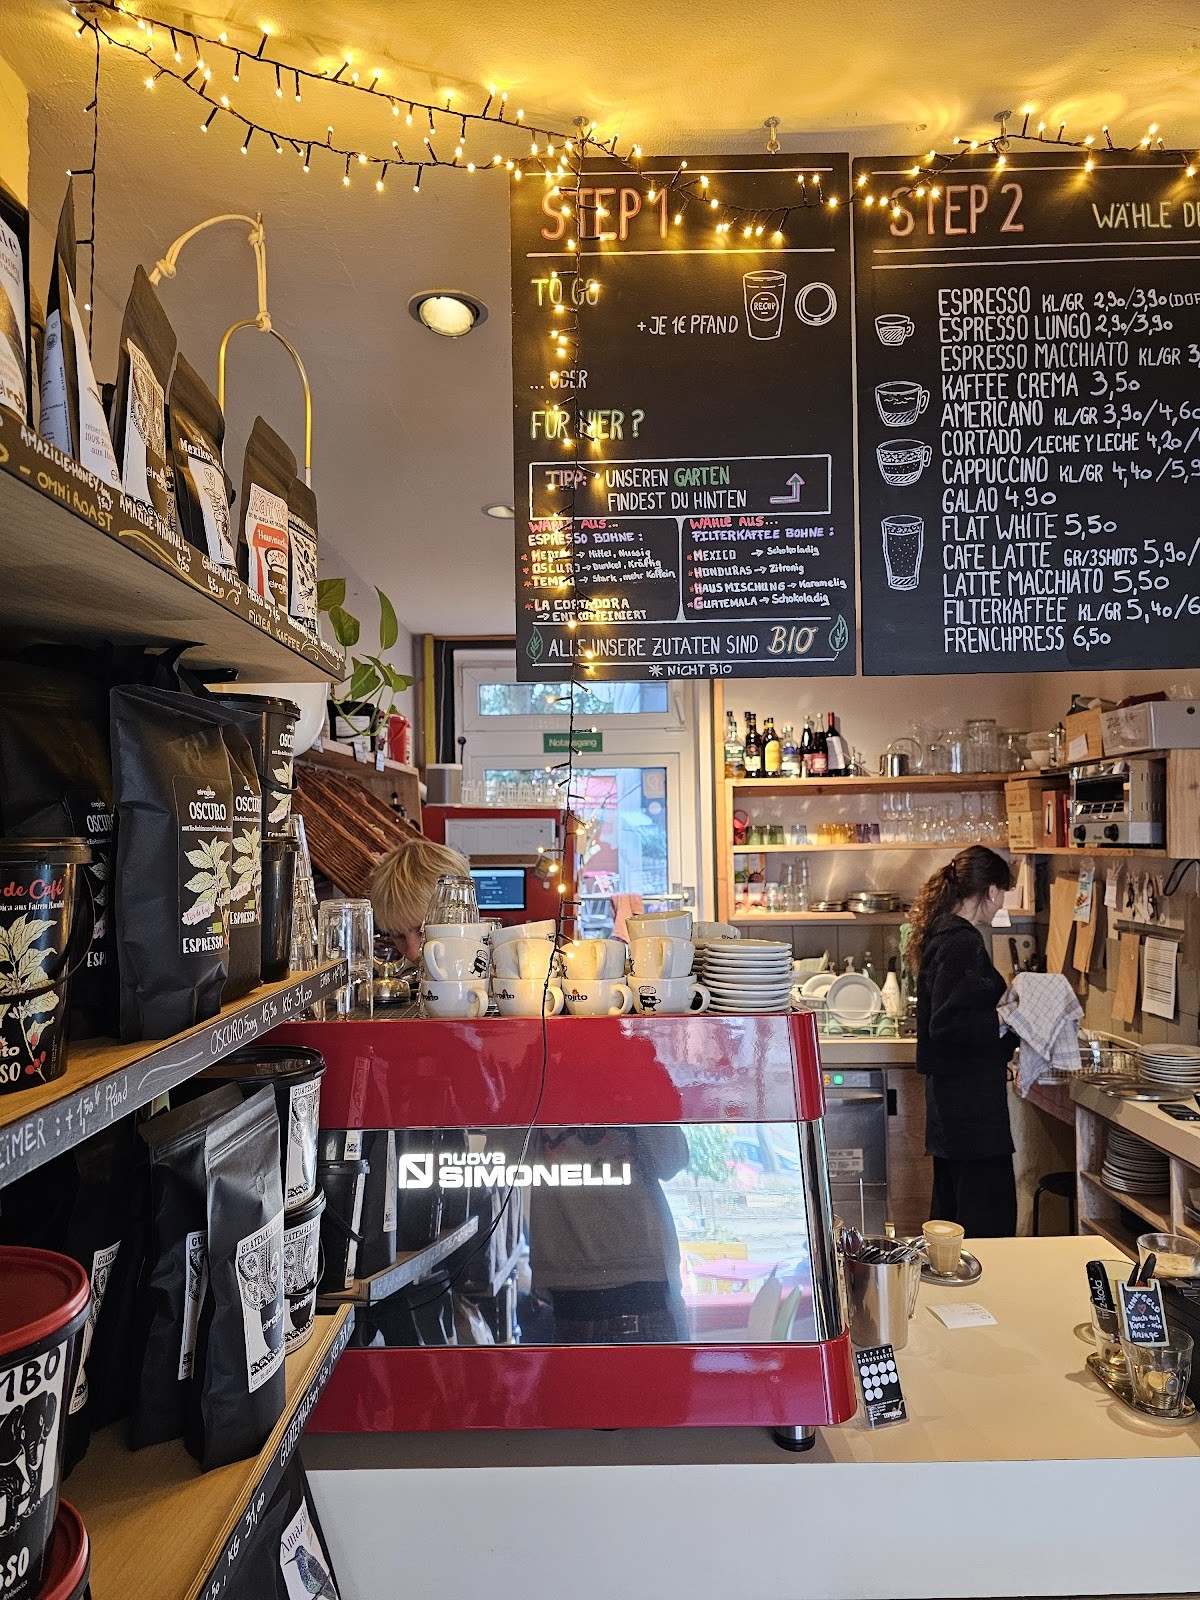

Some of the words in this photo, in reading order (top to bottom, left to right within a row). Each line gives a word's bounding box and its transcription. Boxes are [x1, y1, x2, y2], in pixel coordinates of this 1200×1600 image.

[541, 187, 641, 240] STEP
[651, 187, 668, 239] 1
[890, 184, 988, 237] STEP
[1001, 183, 1024, 232] 2
[1091, 202, 1172, 229] WÄHLE
[531, 278, 562, 306] TO
[572, 278, 599, 305] GO
[938, 286, 1031, 316] ESPRESSO
[1042, 293, 1085, 313] KL/GR
[1094, 286, 1167, 312] 2,90/3,90
[753, 302, 776, 311] RECUP
[690, 314, 739, 335] PFAND
[939, 315, 1029, 343] ESPRESSO
[1034, 313, 1091, 341] LUNGO
[1095, 311, 1173, 336] 2,90/3,90
[940, 345, 1028, 371] ESPRESSO
[1034, 341, 1128, 370] MACCHIATO
[1138, 347, 1181, 366] KL/GR
[941, 372, 1009, 400] KAFFEE
[1017, 369, 1078, 399] CREMA
[1090, 370, 1141, 399] 3,50
[578, 409, 625, 441] HIER
[631, 409, 646, 438] ?
[941, 400, 1043, 428] AMERICANO
[1054, 406, 1098, 426] KL/GR
[941, 428, 1021, 456] CORTADO
[1084, 434, 1095, 452] Y
[1097, 432, 1140, 453] LECHE
[1146, 427, 1200, 454] 4,20/
[605, 468, 668, 488] UNSEREN
[673, 466, 731, 487] GARTEN
[942, 456, 1049, 485] CAPPUCCINO
[1060, 464, 1104, 483] KL/GR
[73, 492, 113, 531] ROAST
[607, 492, 666, 512] FINDEST
[671, 491, 689, 510] DU
[694, 489, 747, 509] HINTEN
[942, 487, 999, 513] GALAO
[1005, 486, 1057, 511] 4,90
[528, 532, 588, 546] ESPRESSO
[594, 532, 635, 544] BOHNE
[692, 529, 780, 542] FILTERKAFFEE
[786, 527, 824, 538] BOHNE
[942, 516, 989, 541] FLAT
[995, 512, 1058, 540] WHITE
[1064, 513, 1118, 540] 5,50
[531, 548, 573, 563] MEDI
[693, 549, 736, 561] MEXICO
[767, 546, 820, 557] Schokoladig
[943, 544, 985, 570] CAFE
[992, 542, 1051, 569] LATTE
[532, 562, 580, 574] OSCURO
[694, 565, 753, 579] HONDURAS
[768, 563, 804, 575] Zitronig
[799, 578, 847, 589] Karamelig
[943, 571, 1001, 597] LATTE
[1008, 568, 1103, 595] MACCHIATO
[1112, 570, 1169, 595] 5,50
[534, 599, 550, 611] LA
[694, 596, 758, 610] GUATEMALA
[772, 593, 830, 606] Schokoladig
[944, 597, 1068, 625] FILTERKAFFEE
[1078, 603, 1121, 621] KL/GR
[548, 638, 586, 657] ALLE
[592, 638, 646, 657] UNSERE
[652, 636, 720, 656] ZUTATEN
[726, 635, 758, 654] SIND
[767, 626, 819, 655] BIO
[944, 626, 1064, 653] FRENCHPRESS
[1073, 626, 1111, 651] 6,50
[189, 801, 227, 820] OSCURO
[3, 884, 28, 898] de
[28, 878, 64, 901] Café
[230, 910, 256, 925] ESPRESSO
[182, 935, 224, 954] ESPRESSO
[211, 1023, 243, 1055] OSCURO
[439, 1152, 505, 1166] nuova
[438, 1163, 632, 1189] SIMONELLI
